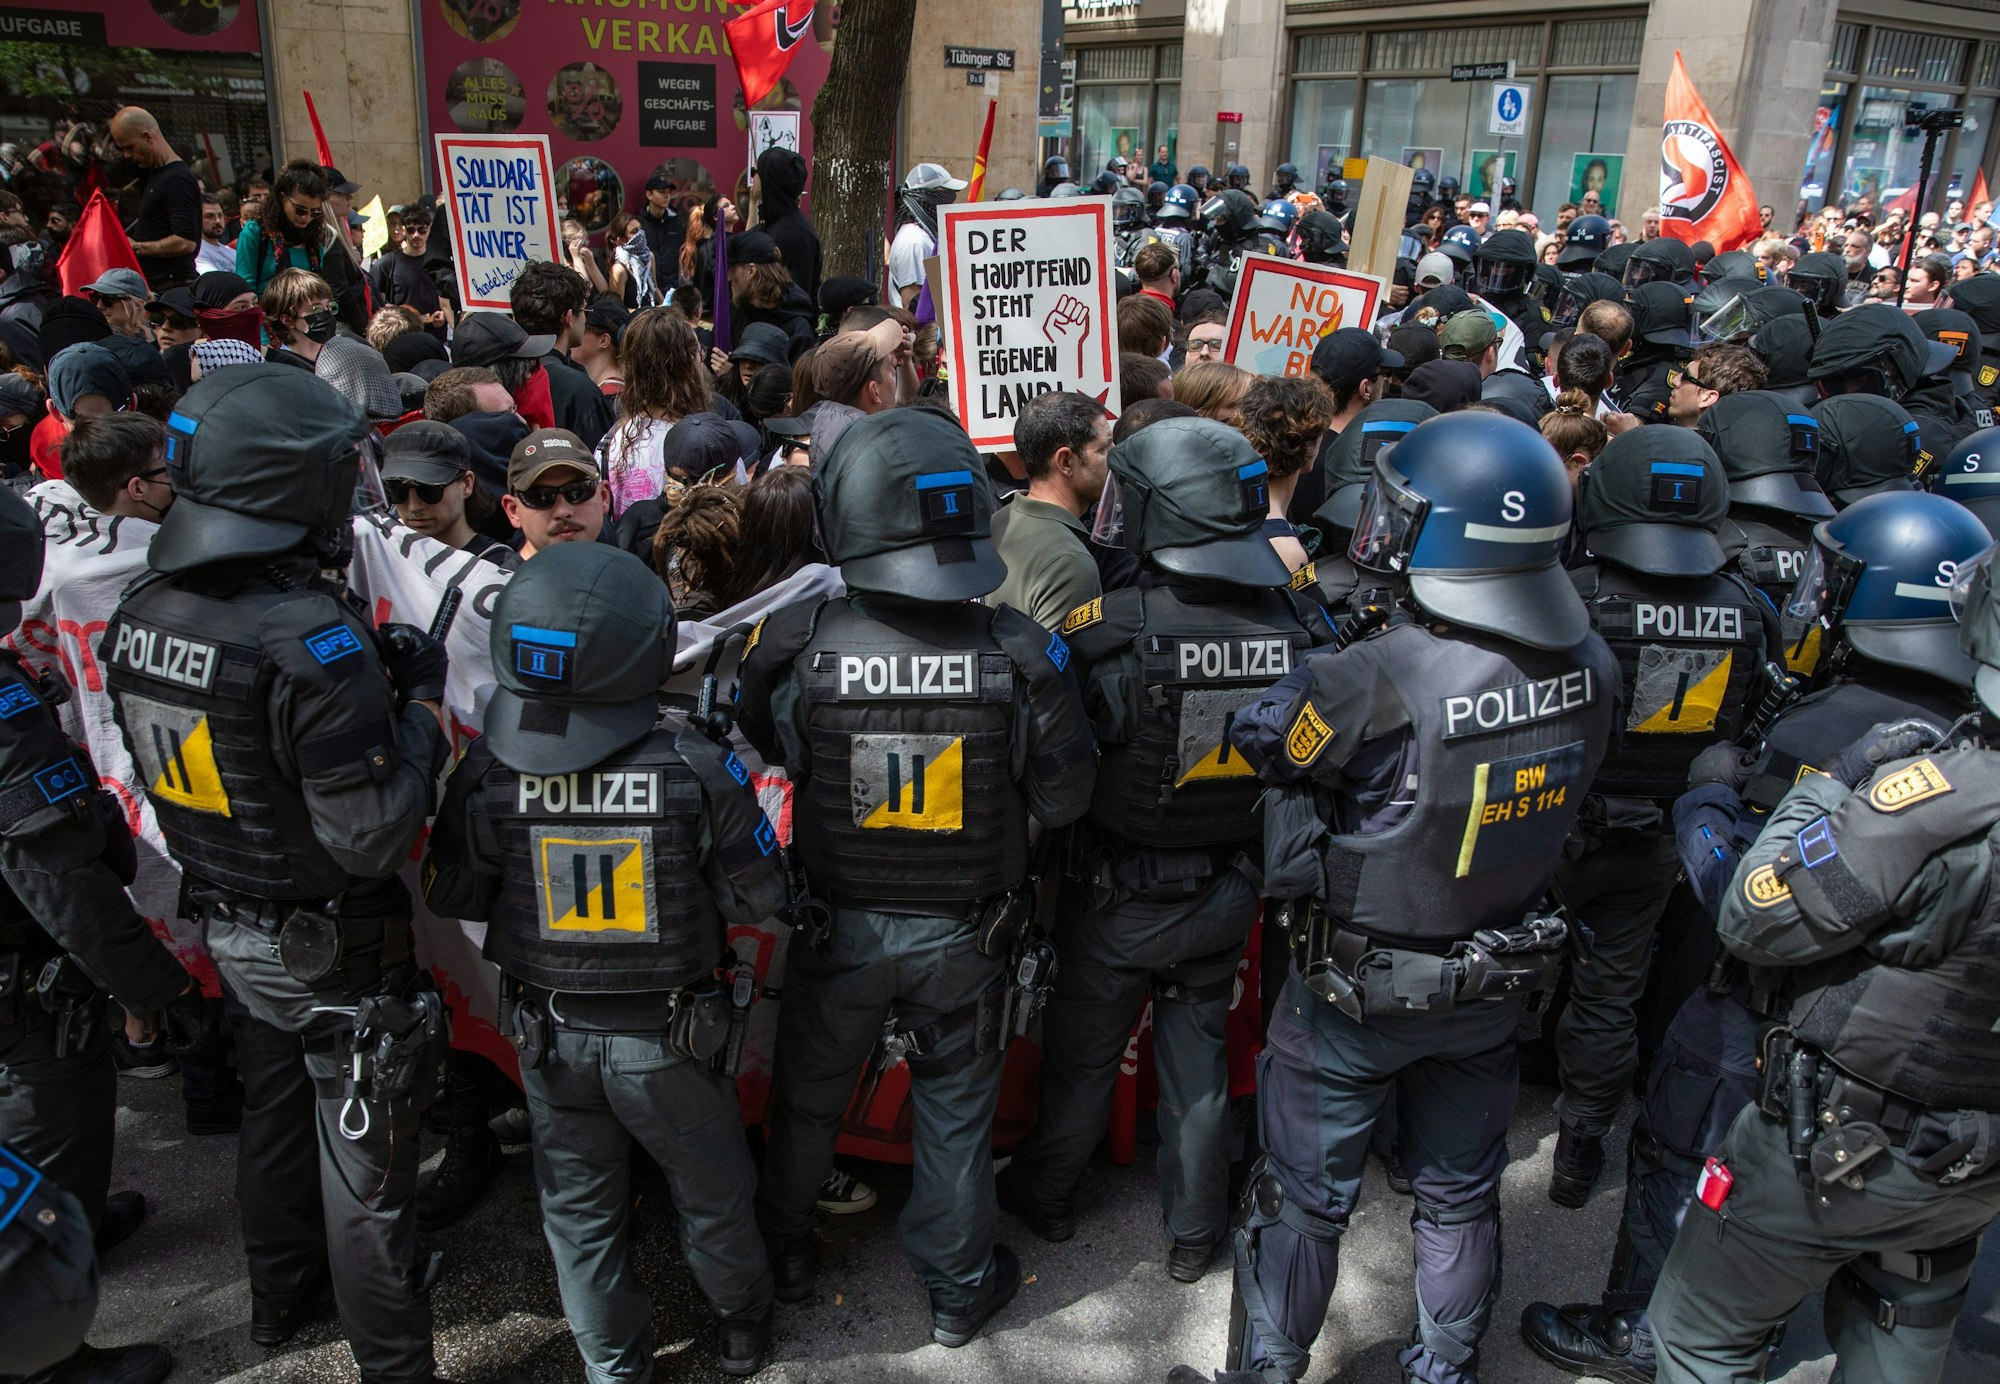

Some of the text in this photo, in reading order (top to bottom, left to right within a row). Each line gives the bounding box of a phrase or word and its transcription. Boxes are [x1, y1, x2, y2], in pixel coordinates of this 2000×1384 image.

[0, 17, 82, 36] UFGABE
[950, 49, 1012, 68] Tübinger Str.
[464, 77, 508, 90] ALLES
[658, 78, 701, 91] WEGEN
[466, 93, 508, 106] MUSS
[644, 98, 715, 111] GESCHÄFTS-
[468, 109, 508, 121] RAUS
[653, 119, 706, 131] AUFGABE
[1497, 122, 1517, 132] ZONE
[456, 156, 541, 191] SOLIDARI-
[456, 191, 538, 225] TÄT IST
[968, 228, 1026, 254] DER
[1577, 228, 1587, 237] 14
[973, 294, 1034, 319] STEHT
[1290, 282, 1339, 318] NO
[977, 324, 1002, 346] IM
[1963, 453, 1980, 472] S
[1501, 490, 1525, 522] S
[1935, 560, 1957, 587] S
[1637, 603, 1742, 640] POLIZEI
[112, 622, 216, 689] POLIZEI
[313, 630, 355, 657] BFE
[1180, 639, 1290, 679] POLIZEI
[841, 654, 973, 695] POLIZEI
[1446, 668, 1592, 734] POLIZEI
[1304, 706, 1328, 737] POLIZEI
[519, 772, 658, 813] POLIZEI
[1515, 764, 1546, 794] BW
[1481, 786, 1566, 825] EH S 114
